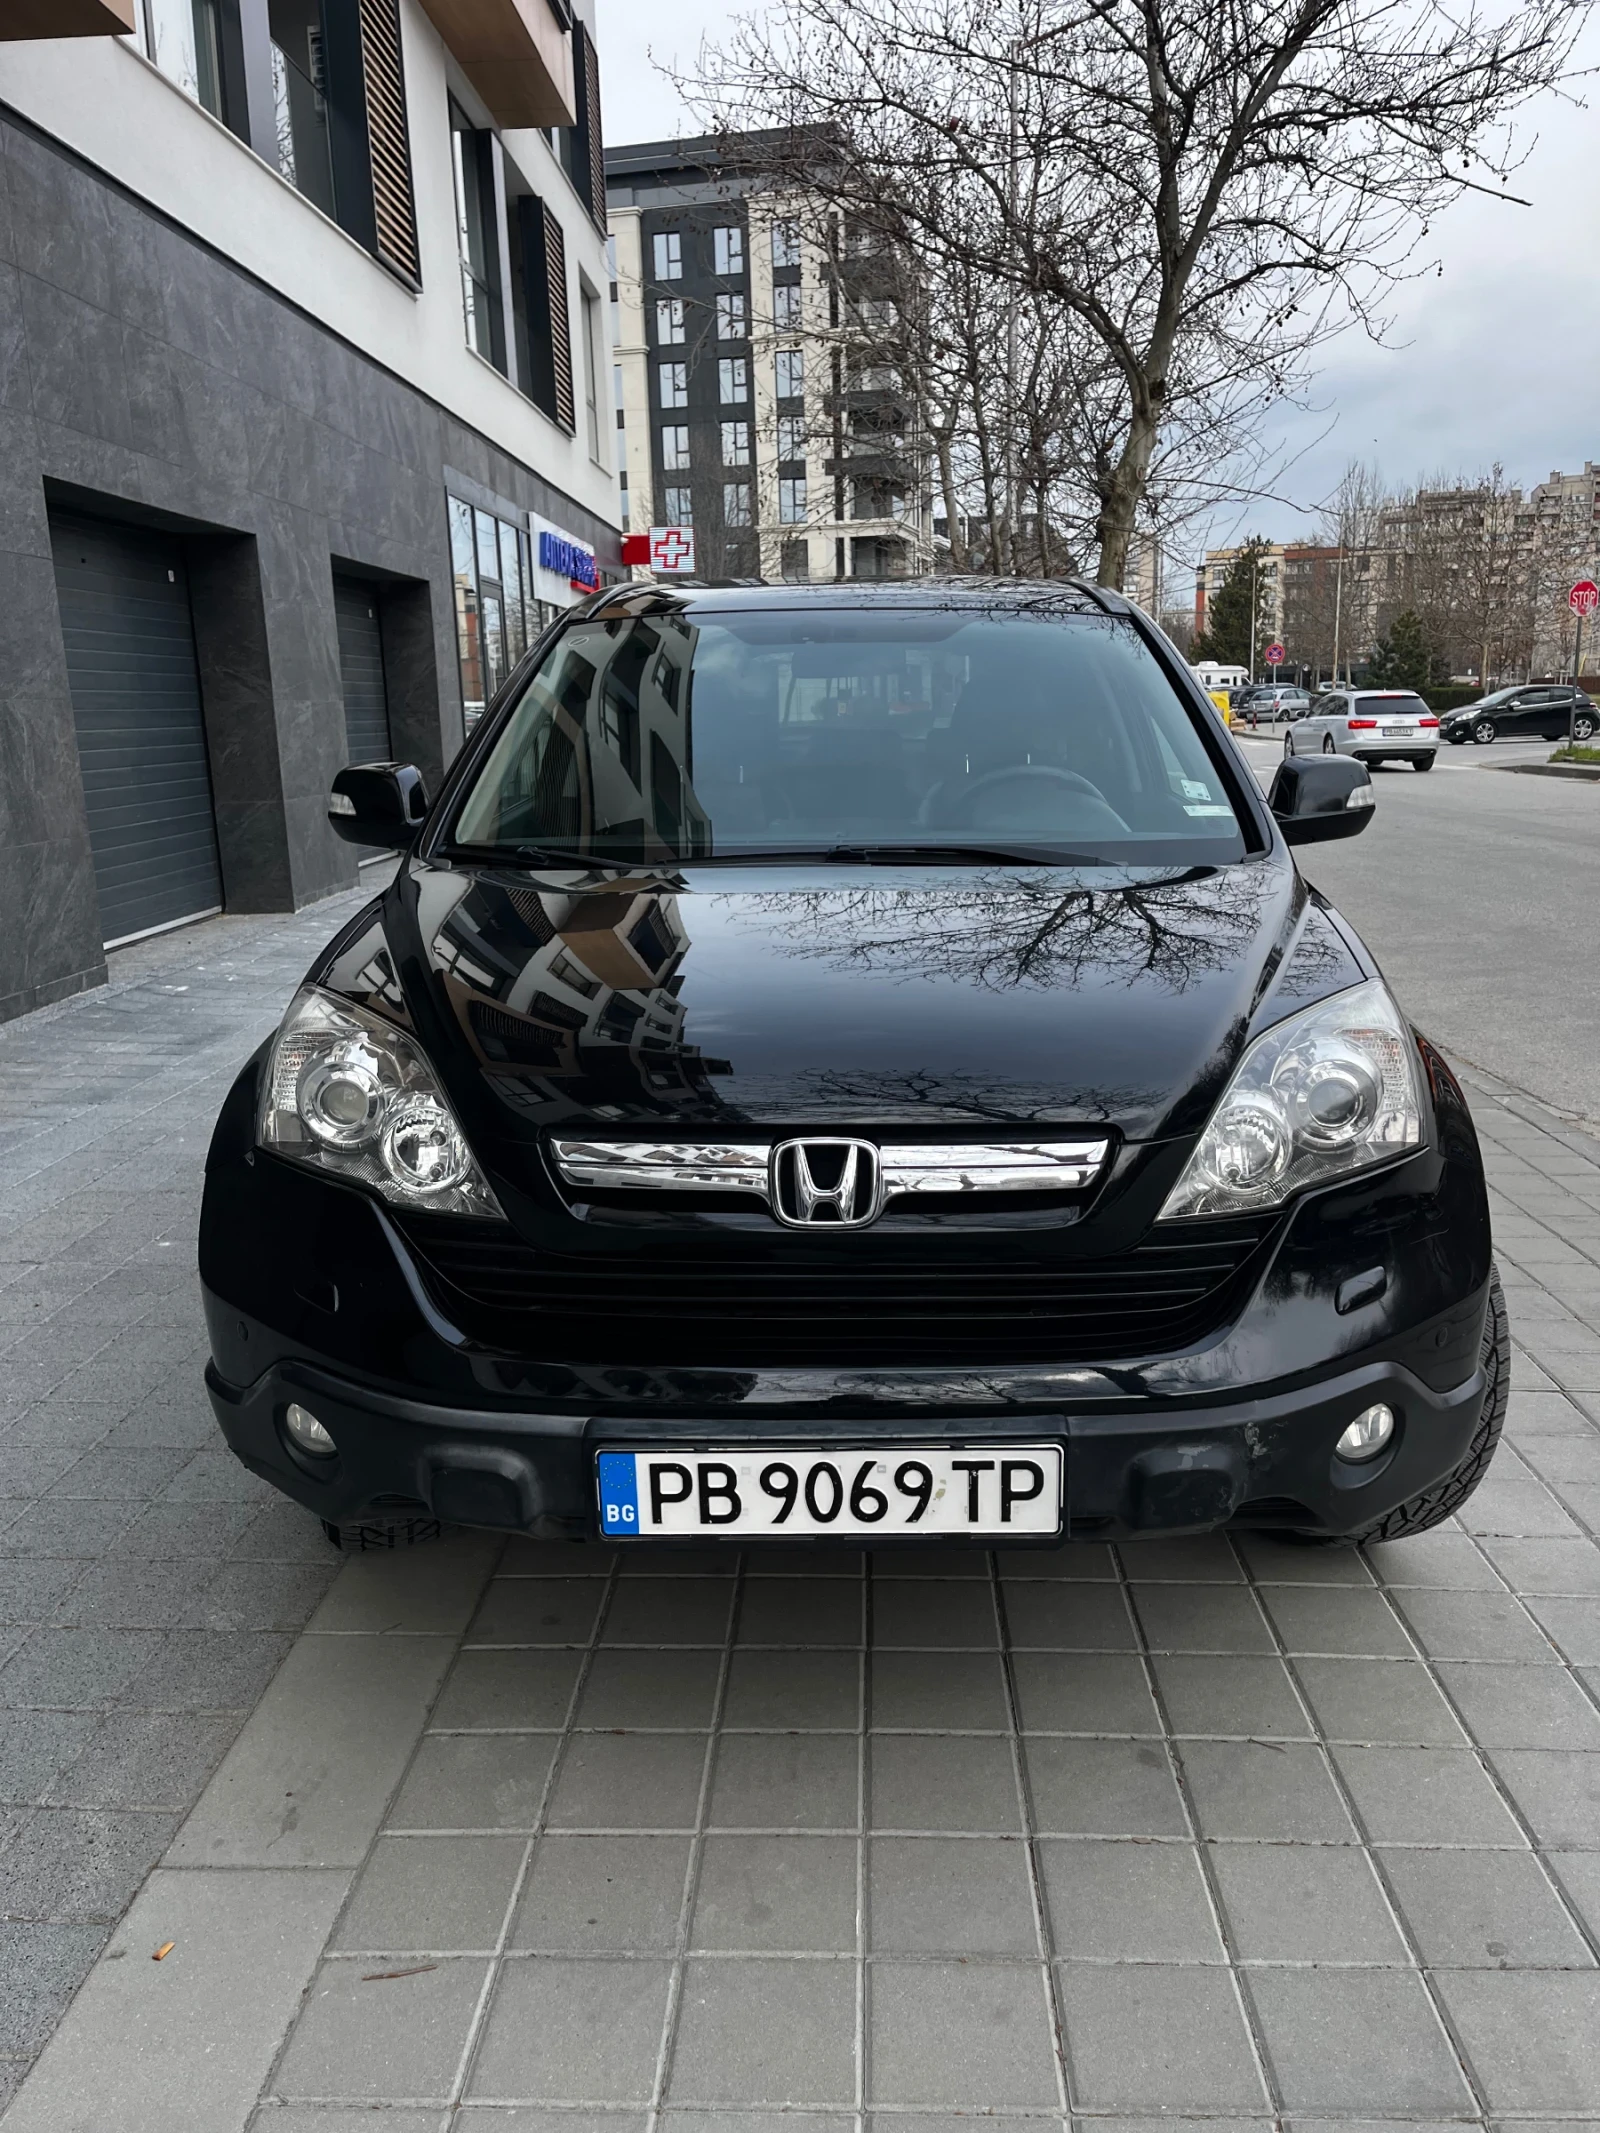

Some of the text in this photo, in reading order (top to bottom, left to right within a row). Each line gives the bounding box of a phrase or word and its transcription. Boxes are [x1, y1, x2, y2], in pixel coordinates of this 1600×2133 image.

[1572, 590, 1596, 606] STOP
[649, 1460, 1045, 1524] PB 9069 TP
[606, 1504, 635, 1522] BG
